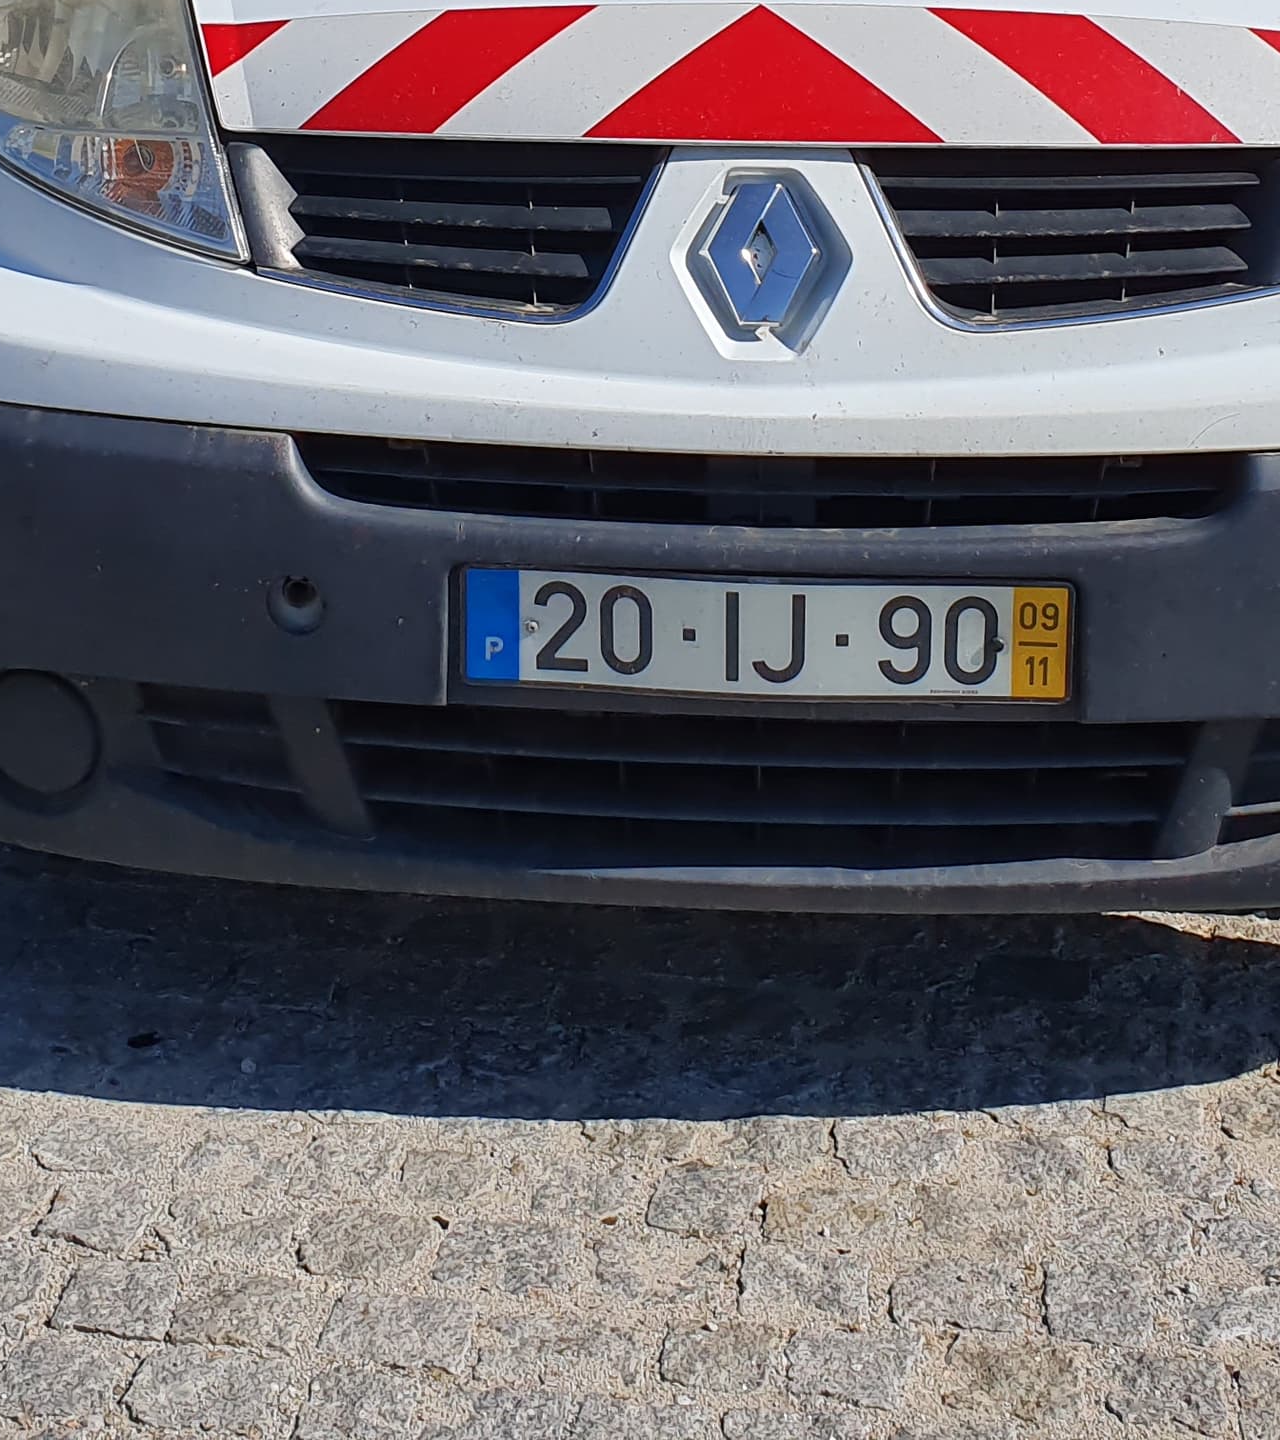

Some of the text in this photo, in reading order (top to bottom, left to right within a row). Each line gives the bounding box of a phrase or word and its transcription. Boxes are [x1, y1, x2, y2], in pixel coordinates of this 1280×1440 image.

[485, 635, 504, 662] P
[1019, 601, 1060, 632] 09
[1024, 656, 1052, 686] 11
